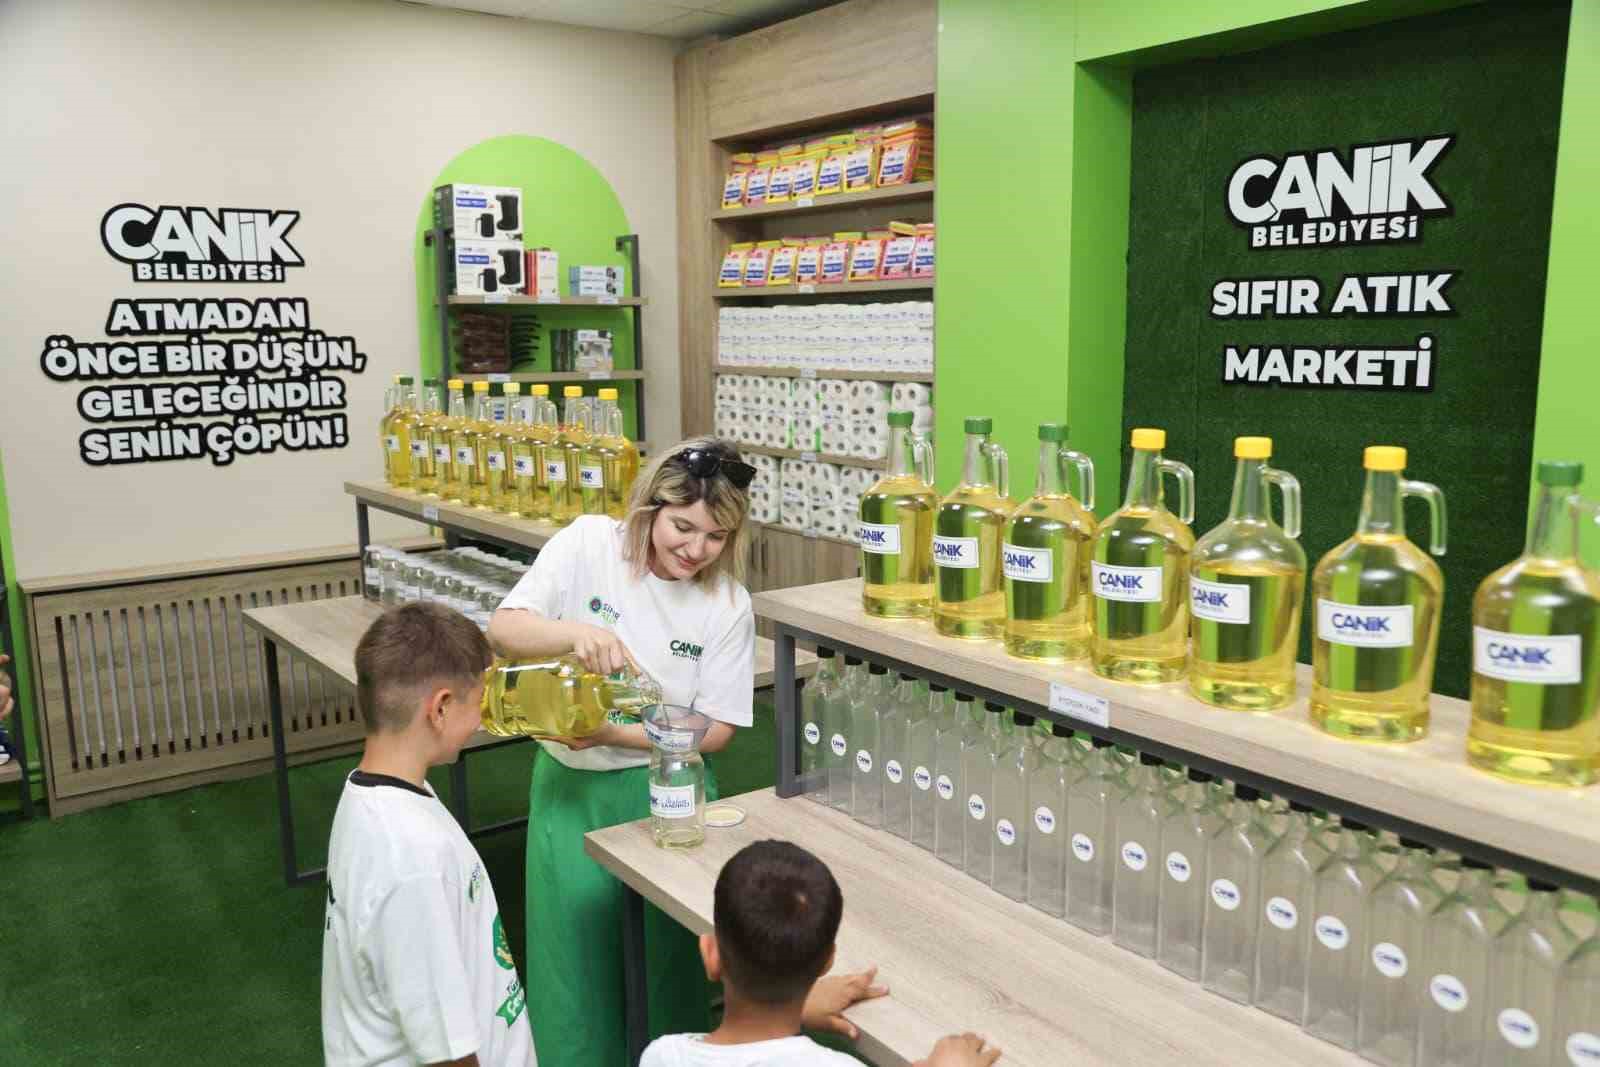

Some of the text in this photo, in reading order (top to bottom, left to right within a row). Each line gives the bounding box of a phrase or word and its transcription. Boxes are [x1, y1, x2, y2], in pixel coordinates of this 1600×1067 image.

[109, 301, 307, 331] ATMADAN
[1211, 273, 1453, 316] SIFIR ATIK
[44, 334, 365, 377] ÖNCE BİR DÜŞÜN,
[1224, 336, 1433, 387] MARKETİ
[81, 374, 344, 418] GELECEĞİNDİR
[83, 414, 346, 462] SENİN ÇÖPÜN!
